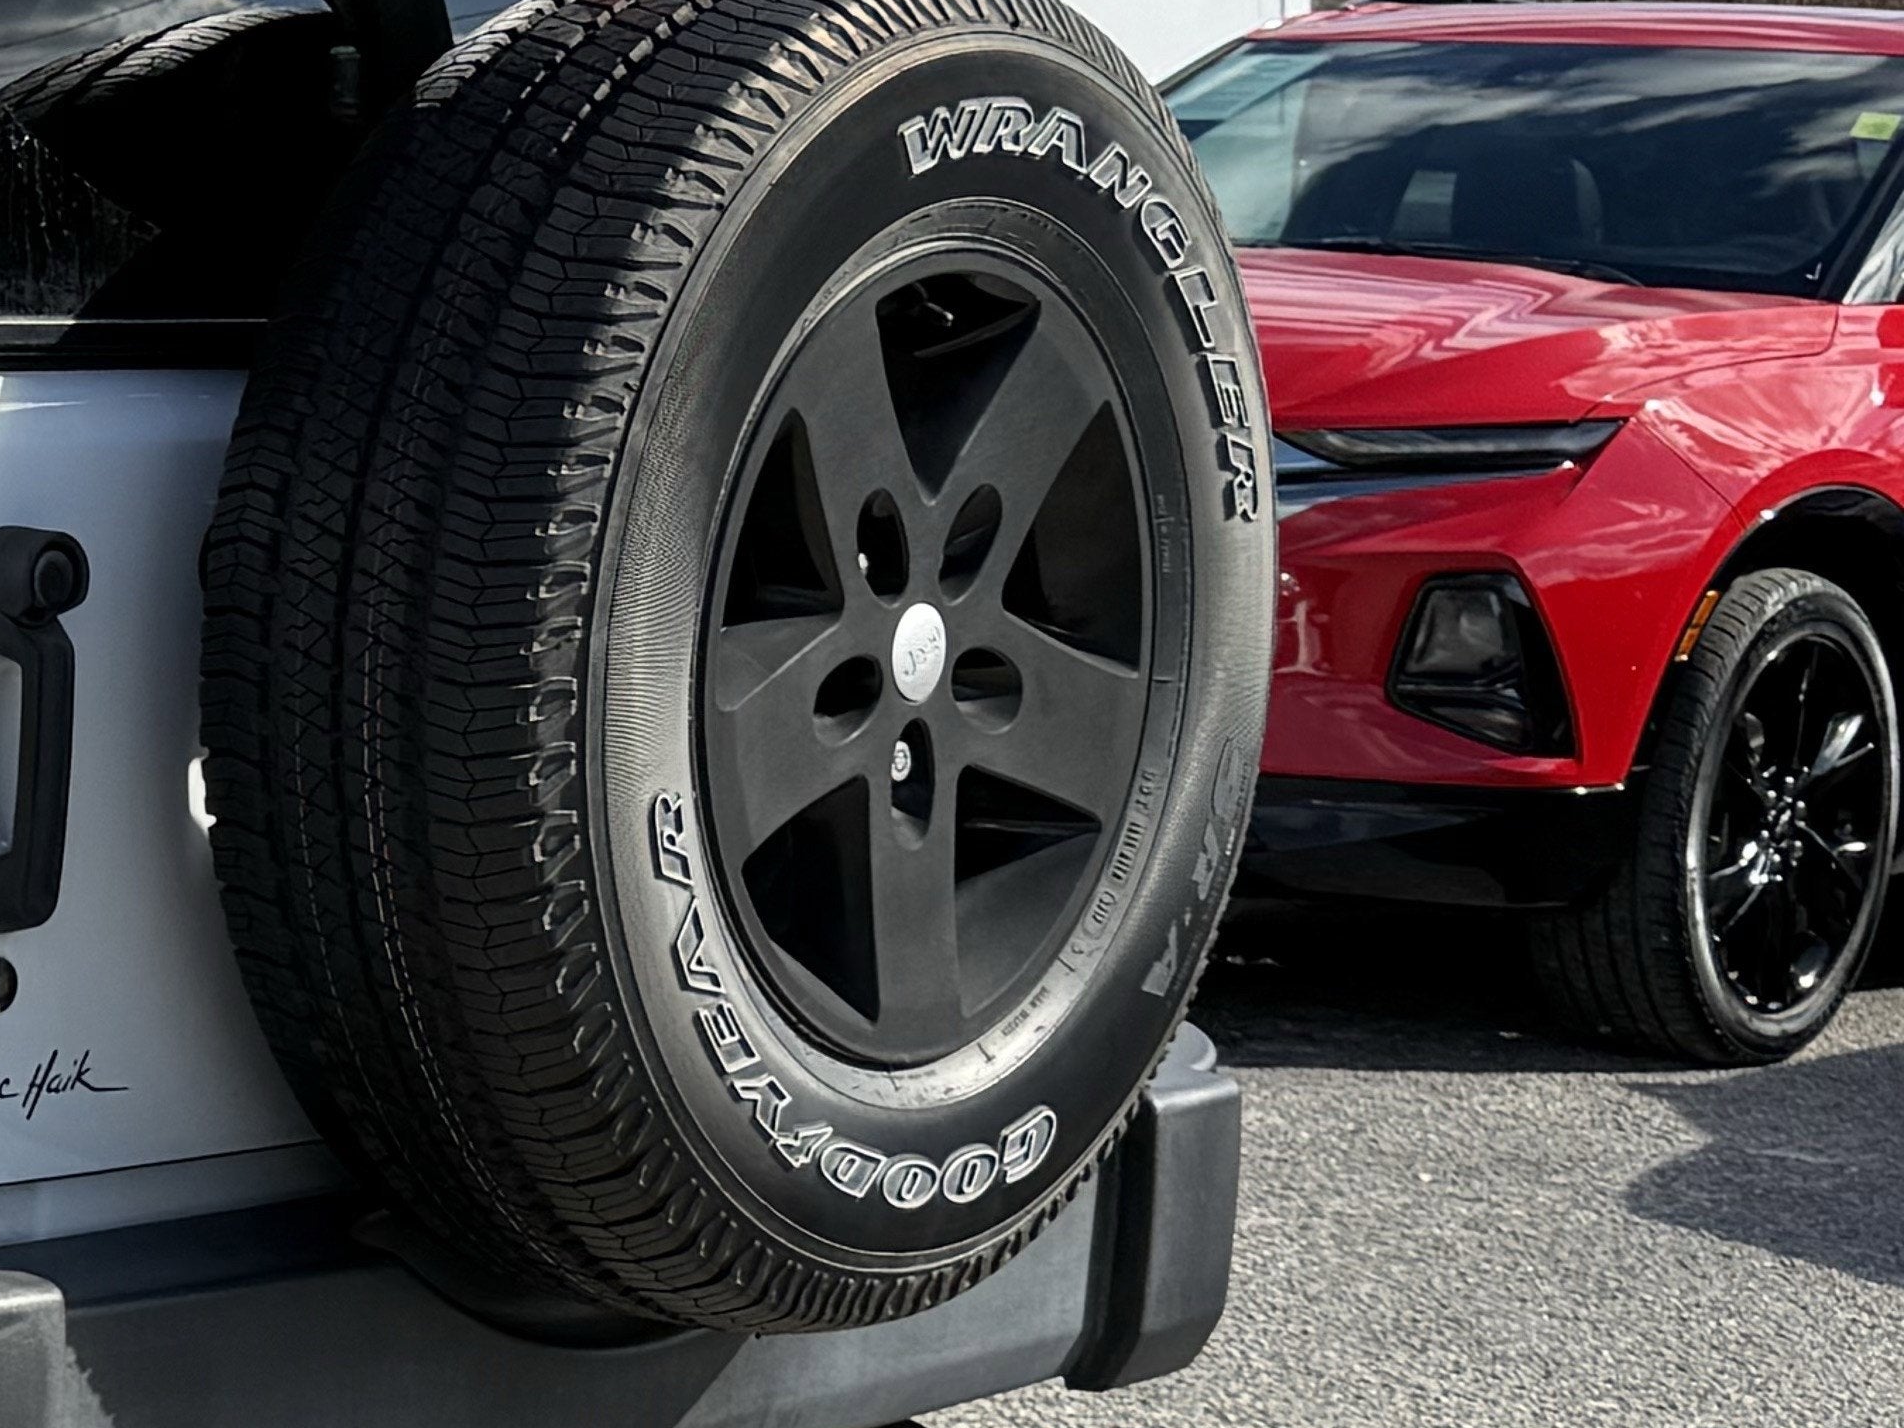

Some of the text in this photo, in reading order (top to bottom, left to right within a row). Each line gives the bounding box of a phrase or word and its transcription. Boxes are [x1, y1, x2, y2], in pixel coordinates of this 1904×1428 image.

[900, 95, 1260, 524] WRANGLER
[22, 1048, 129, 1120] Haik
[647, 788, 1060, 1212] GOODYEAR
